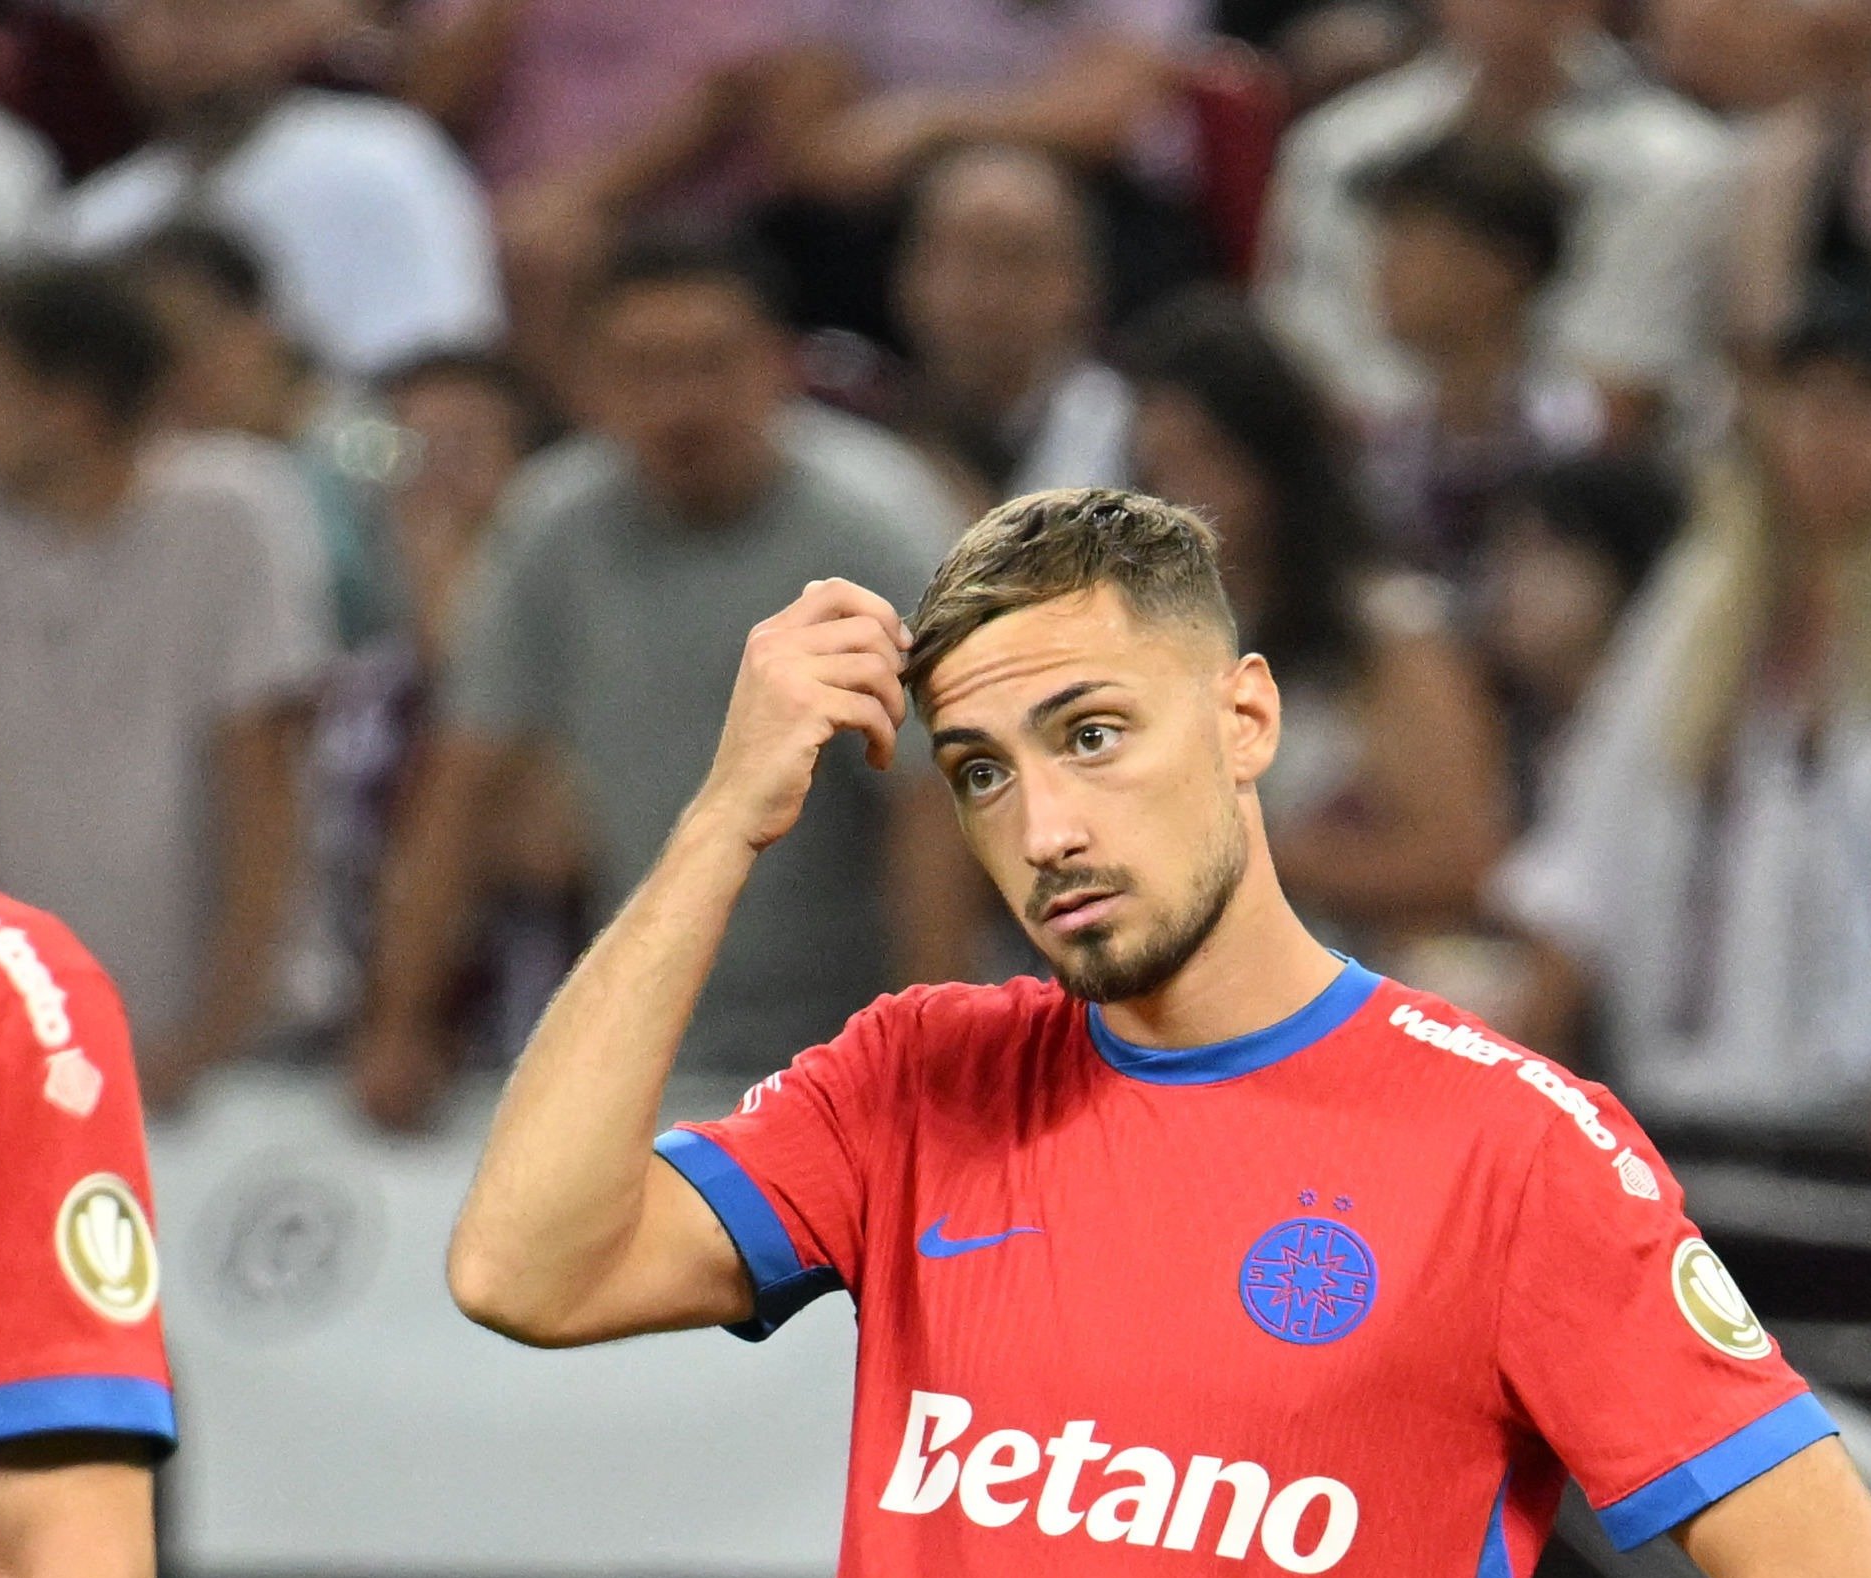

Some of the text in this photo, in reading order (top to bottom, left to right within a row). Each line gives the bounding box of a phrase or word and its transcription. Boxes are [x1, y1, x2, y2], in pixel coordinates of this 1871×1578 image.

[1389, 1004, 1618, 1151] walter tosto
[877, 1388, 1361, 1575] Betano
